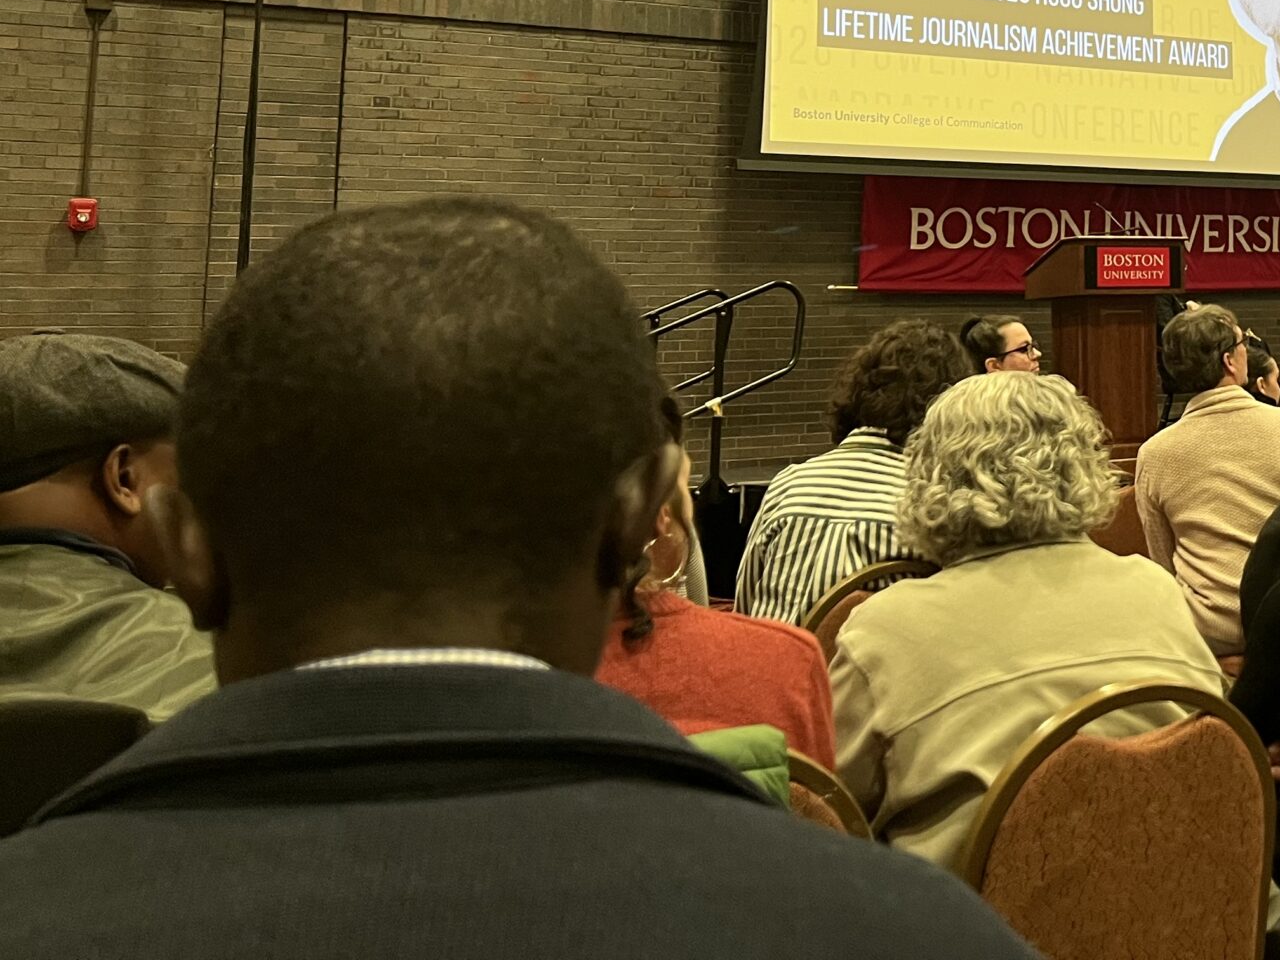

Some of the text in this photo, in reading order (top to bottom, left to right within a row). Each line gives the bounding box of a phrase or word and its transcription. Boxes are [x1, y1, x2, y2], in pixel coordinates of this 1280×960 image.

[823, 8, 1229, 69] LIFETIME JOURNALISM ACHIEVEMENT AWARD
[793, 107, 1024, 132] Boston University College of Communication
[909, 206, 1091, 251] BOSTON
[1103, 253, 1164, 267] BOSTON
[1103, 270, 1164, 280] UNIVERSITY
